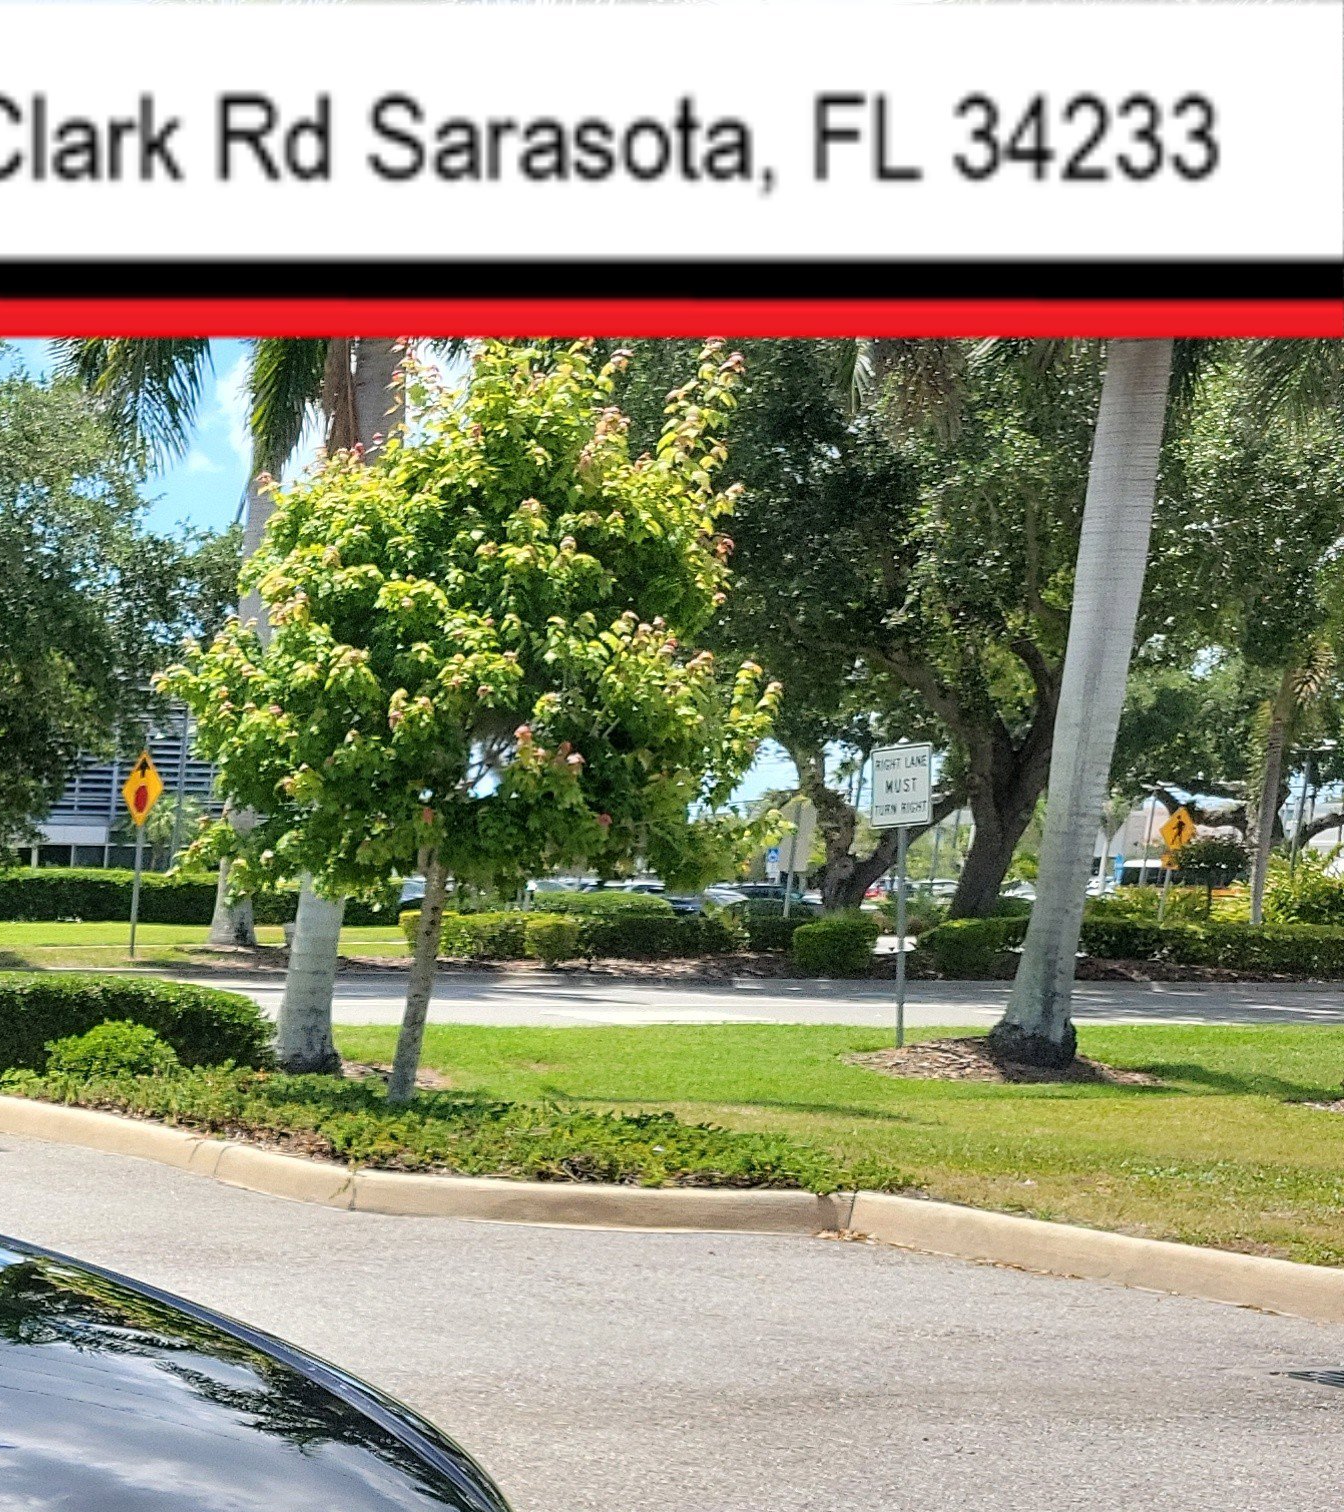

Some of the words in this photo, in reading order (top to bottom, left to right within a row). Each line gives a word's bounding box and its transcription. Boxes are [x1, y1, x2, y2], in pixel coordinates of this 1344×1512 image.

[875, 758, 900, 771] RIGHT
[905, 755, 927, 768] LANE
[885, 777, 917, 793] MUST
[875, 804, 897, 816] TURN
[900, 800, 927, 813] RIGHT
